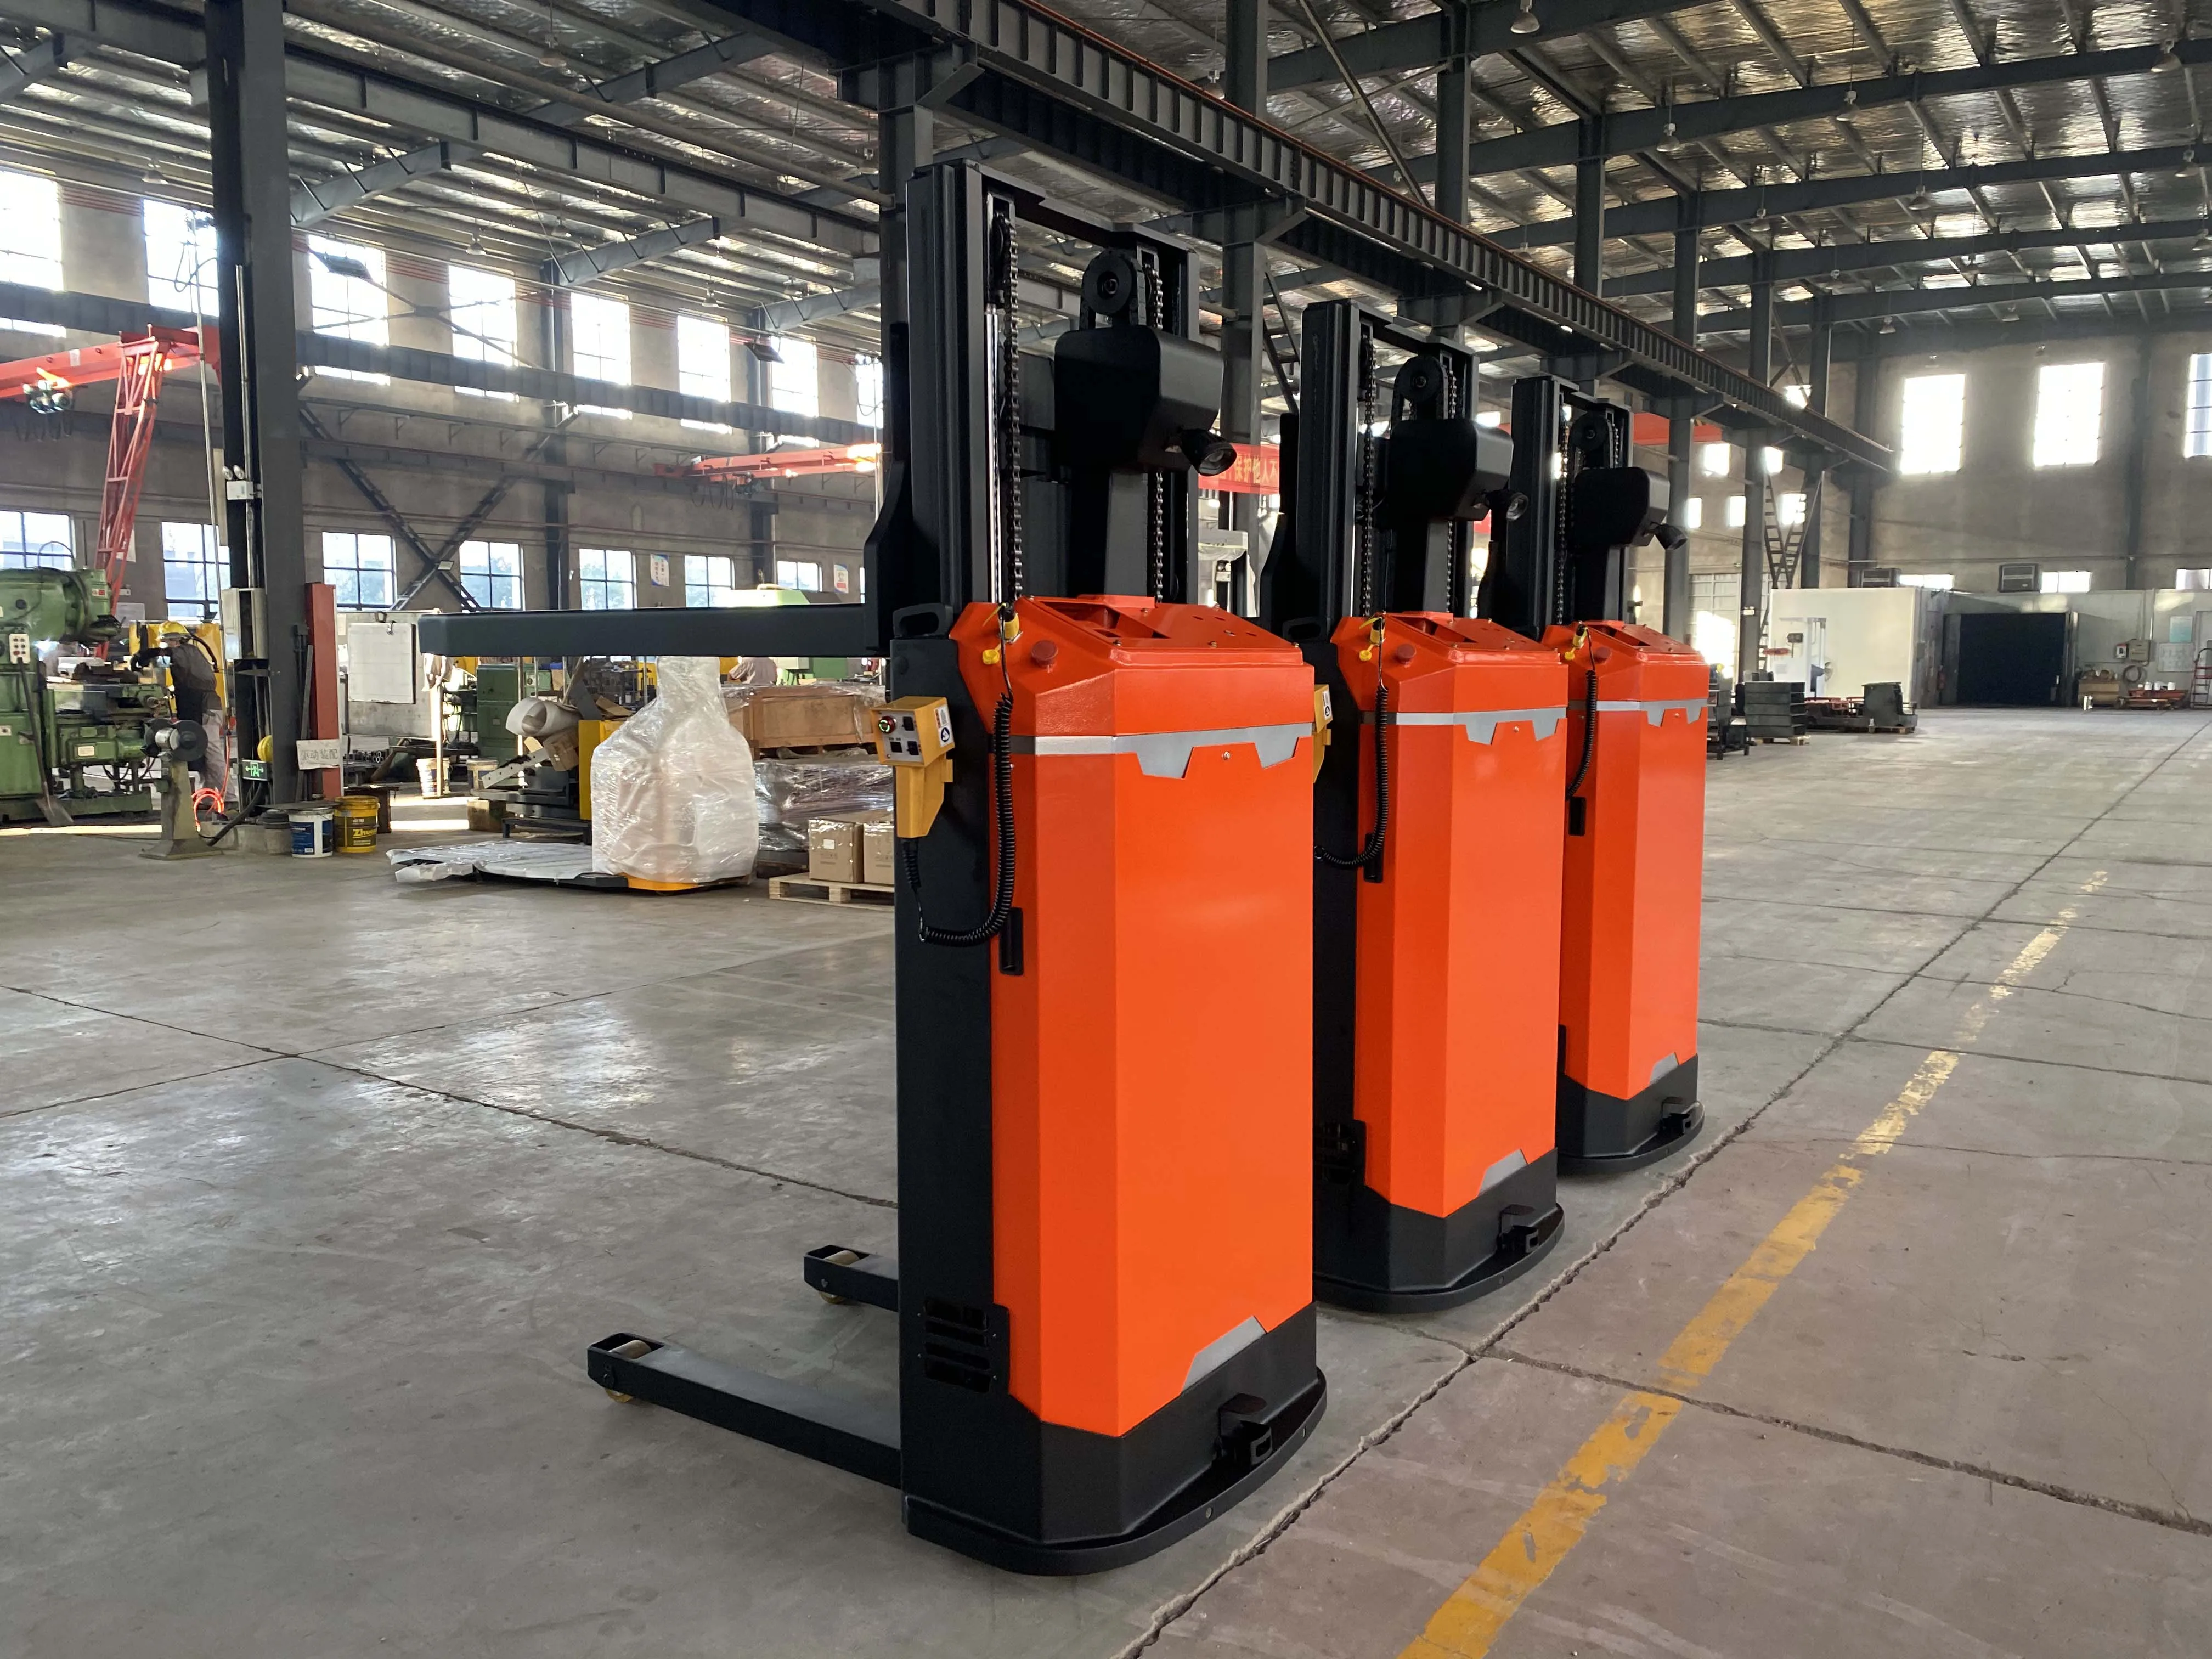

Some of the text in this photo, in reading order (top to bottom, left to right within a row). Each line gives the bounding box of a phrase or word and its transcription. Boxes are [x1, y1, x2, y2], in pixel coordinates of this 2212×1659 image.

[1220, 454, 1278, 484] 保护他人不
